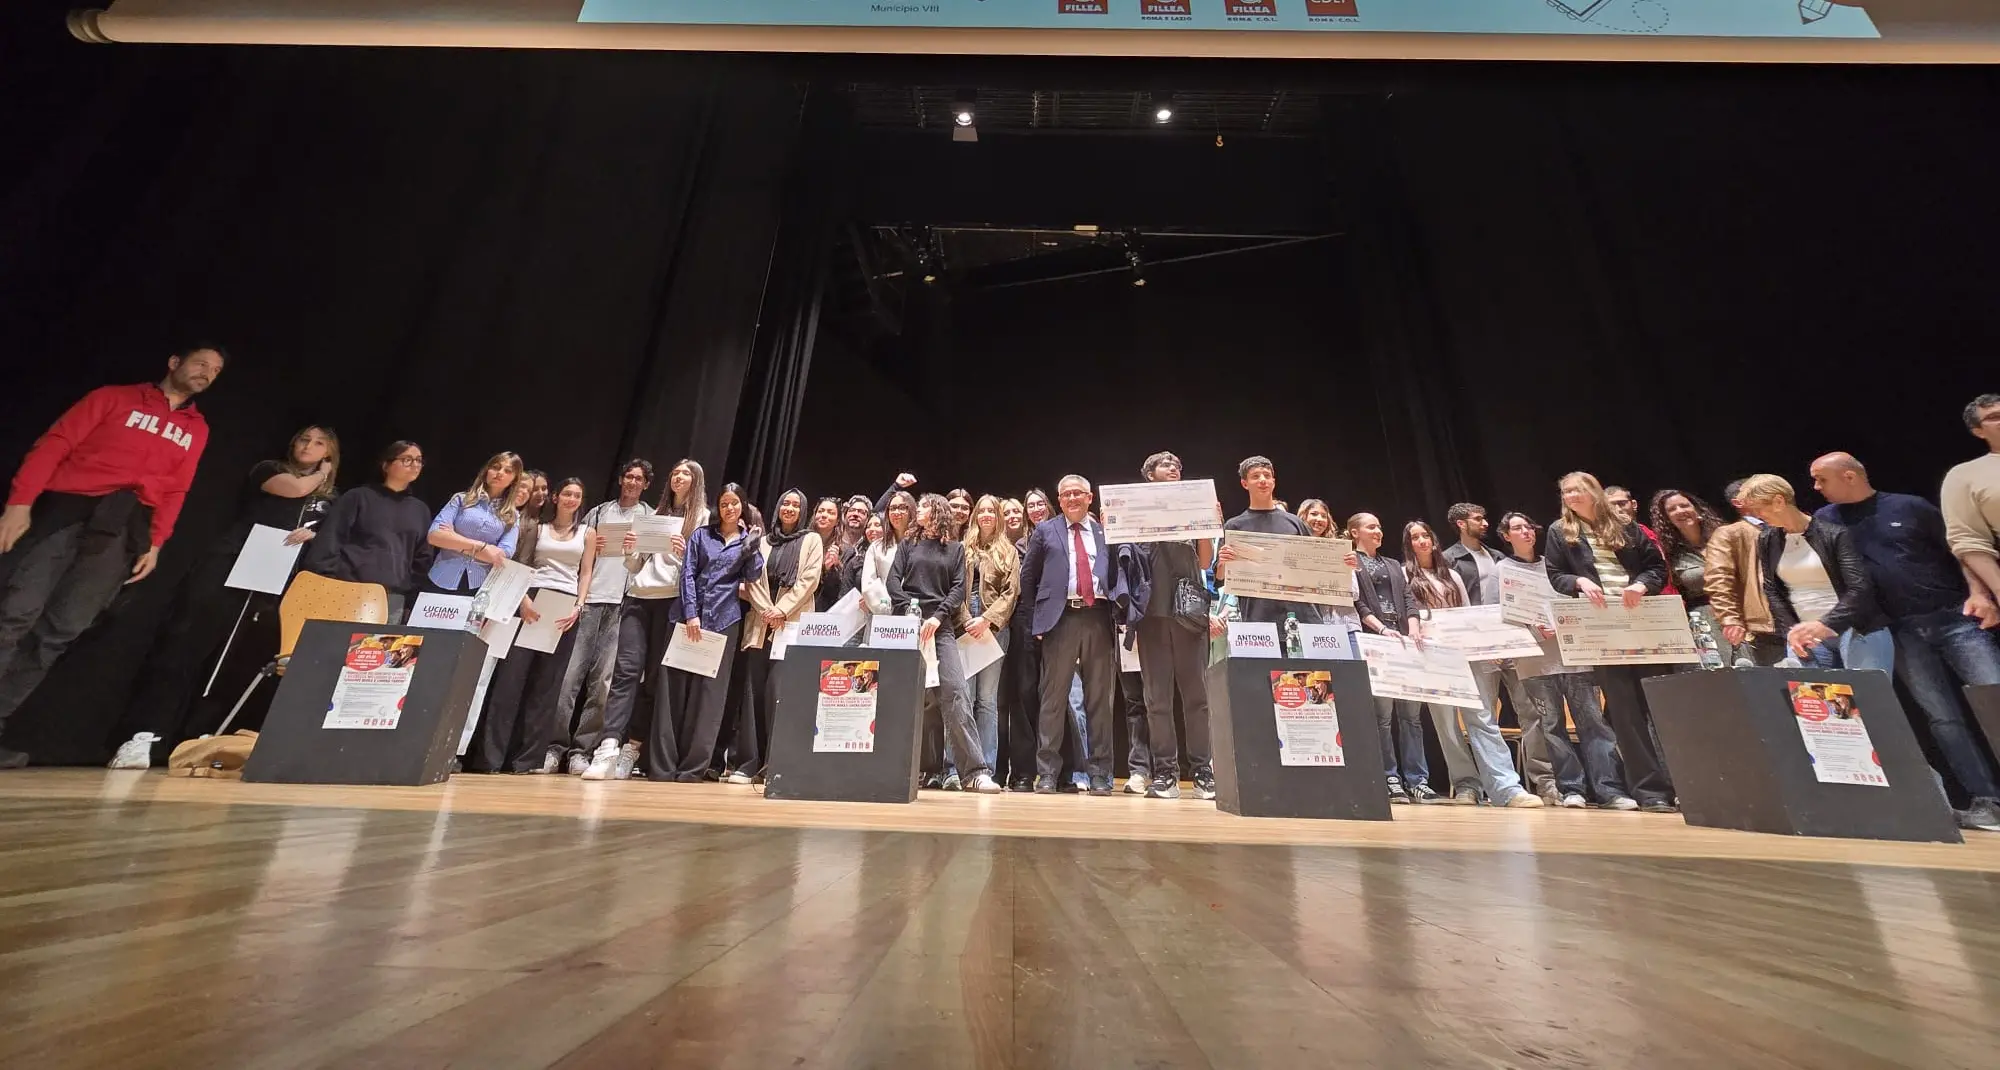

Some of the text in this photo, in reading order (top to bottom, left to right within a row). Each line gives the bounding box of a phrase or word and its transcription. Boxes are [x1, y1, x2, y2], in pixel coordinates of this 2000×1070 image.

[870, 4, 919, 13] Municipio
[423, 605, 459, 614] LUCIANA
[424, 611, 455, 619] CIMINO
[812, 629, 841, 637] VECCHIS
[874, 626, 915, 635] DONATELLA
[1244, 640, 1275, 648] FRANCO
